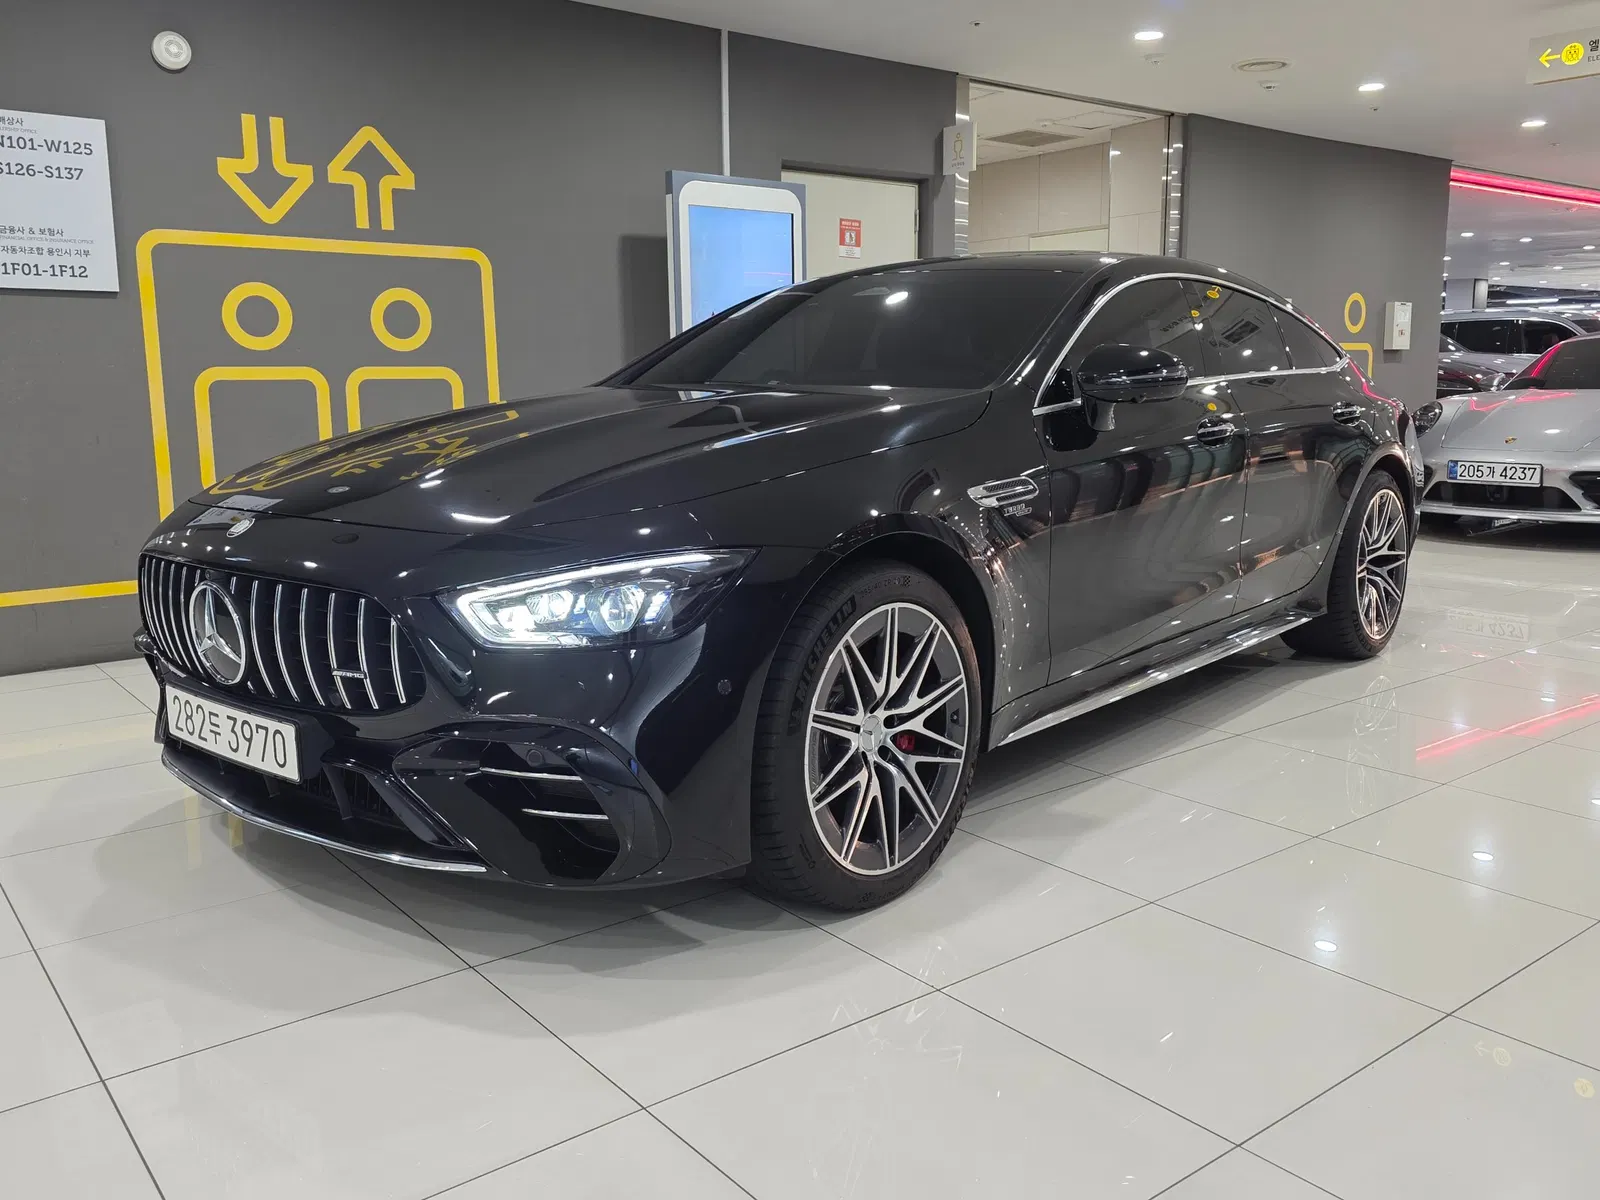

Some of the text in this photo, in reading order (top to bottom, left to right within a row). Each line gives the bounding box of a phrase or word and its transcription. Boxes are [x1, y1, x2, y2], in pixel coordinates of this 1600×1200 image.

[0, 225, 64, 237] 금융사 & 보험사
[1, 245, 91, 258] 자동차조합 용인시 지부
[1, 262, 89, 278] 1F01-1F12
[1459, 464, 1538, 481] 205가 4237
[796, 599, 855, 703] MICHELIN
[172, 695, 287, 769] 282두 3970
